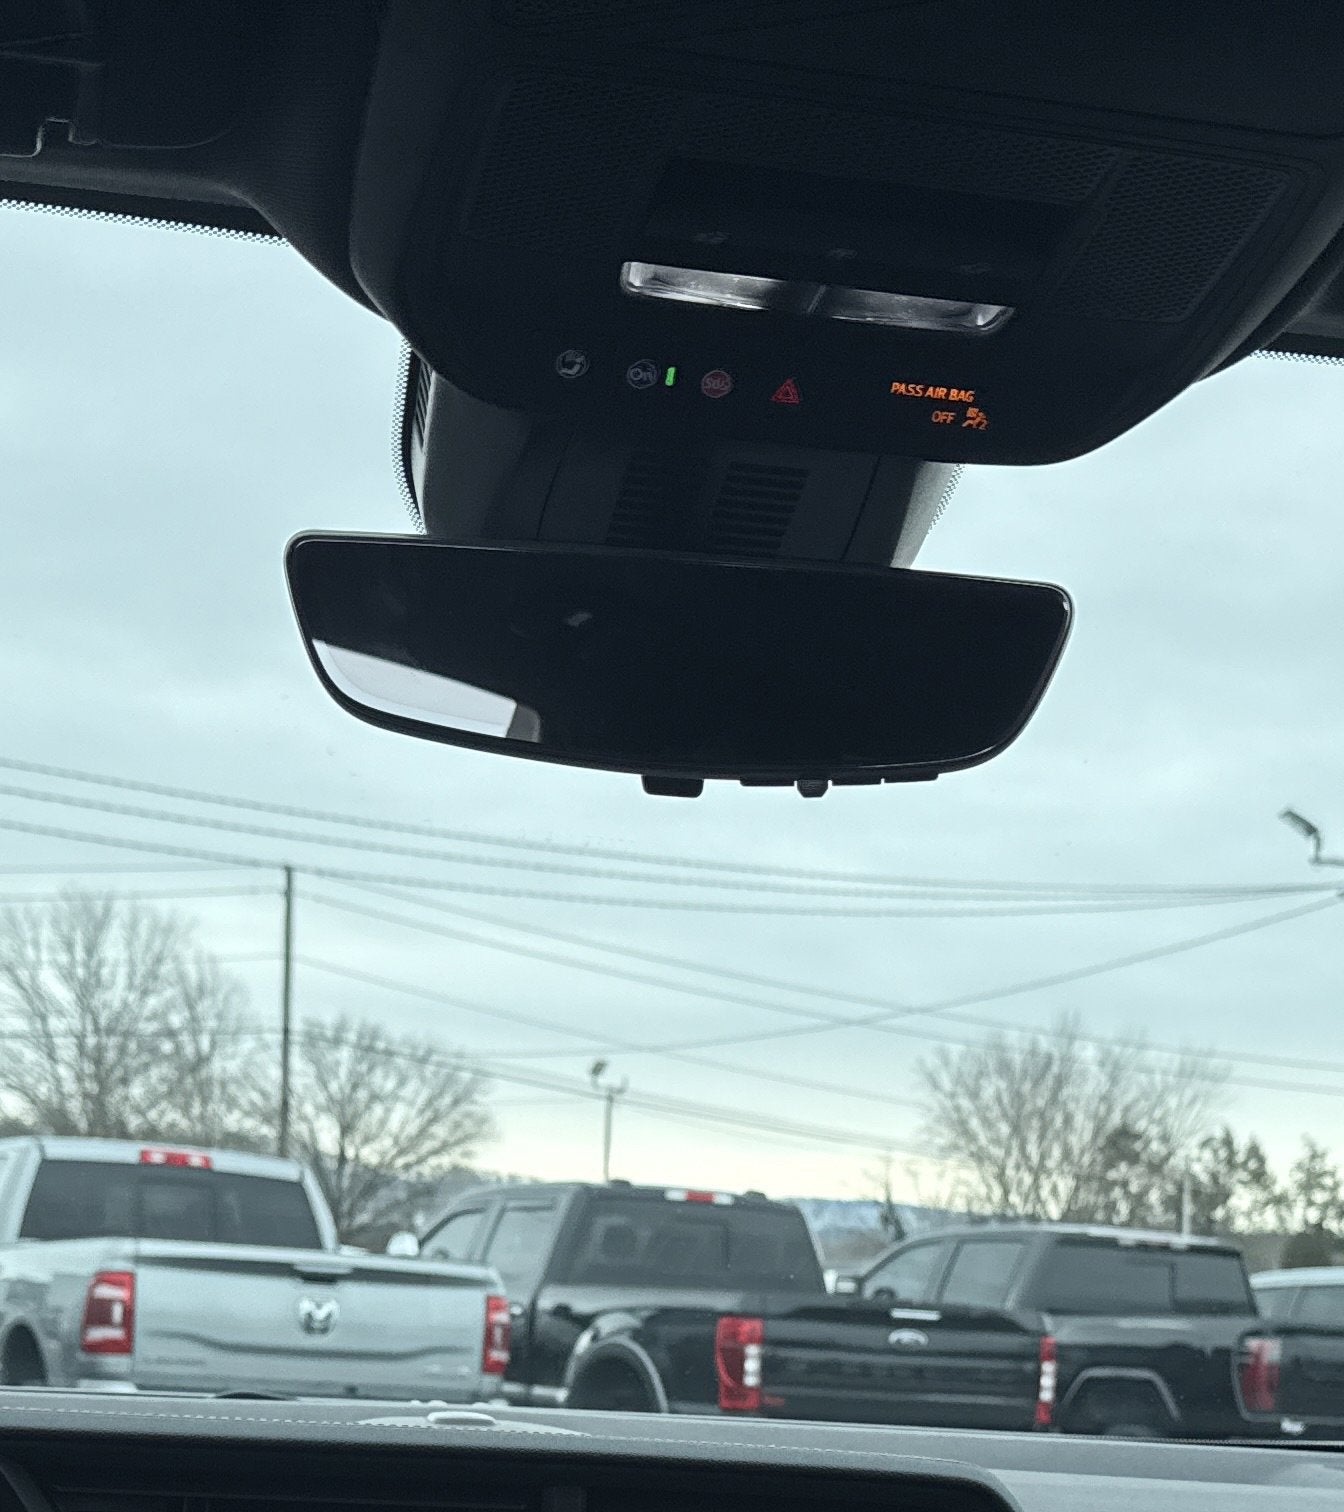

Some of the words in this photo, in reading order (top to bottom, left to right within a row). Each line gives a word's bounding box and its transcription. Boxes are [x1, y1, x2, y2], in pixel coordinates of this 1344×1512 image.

[890, 381, 924, 397] PASS
[925, 386, 947, 400] AIR
[948, 388, 976, 403] BAG
[931, 410, 956, 424] OFF
